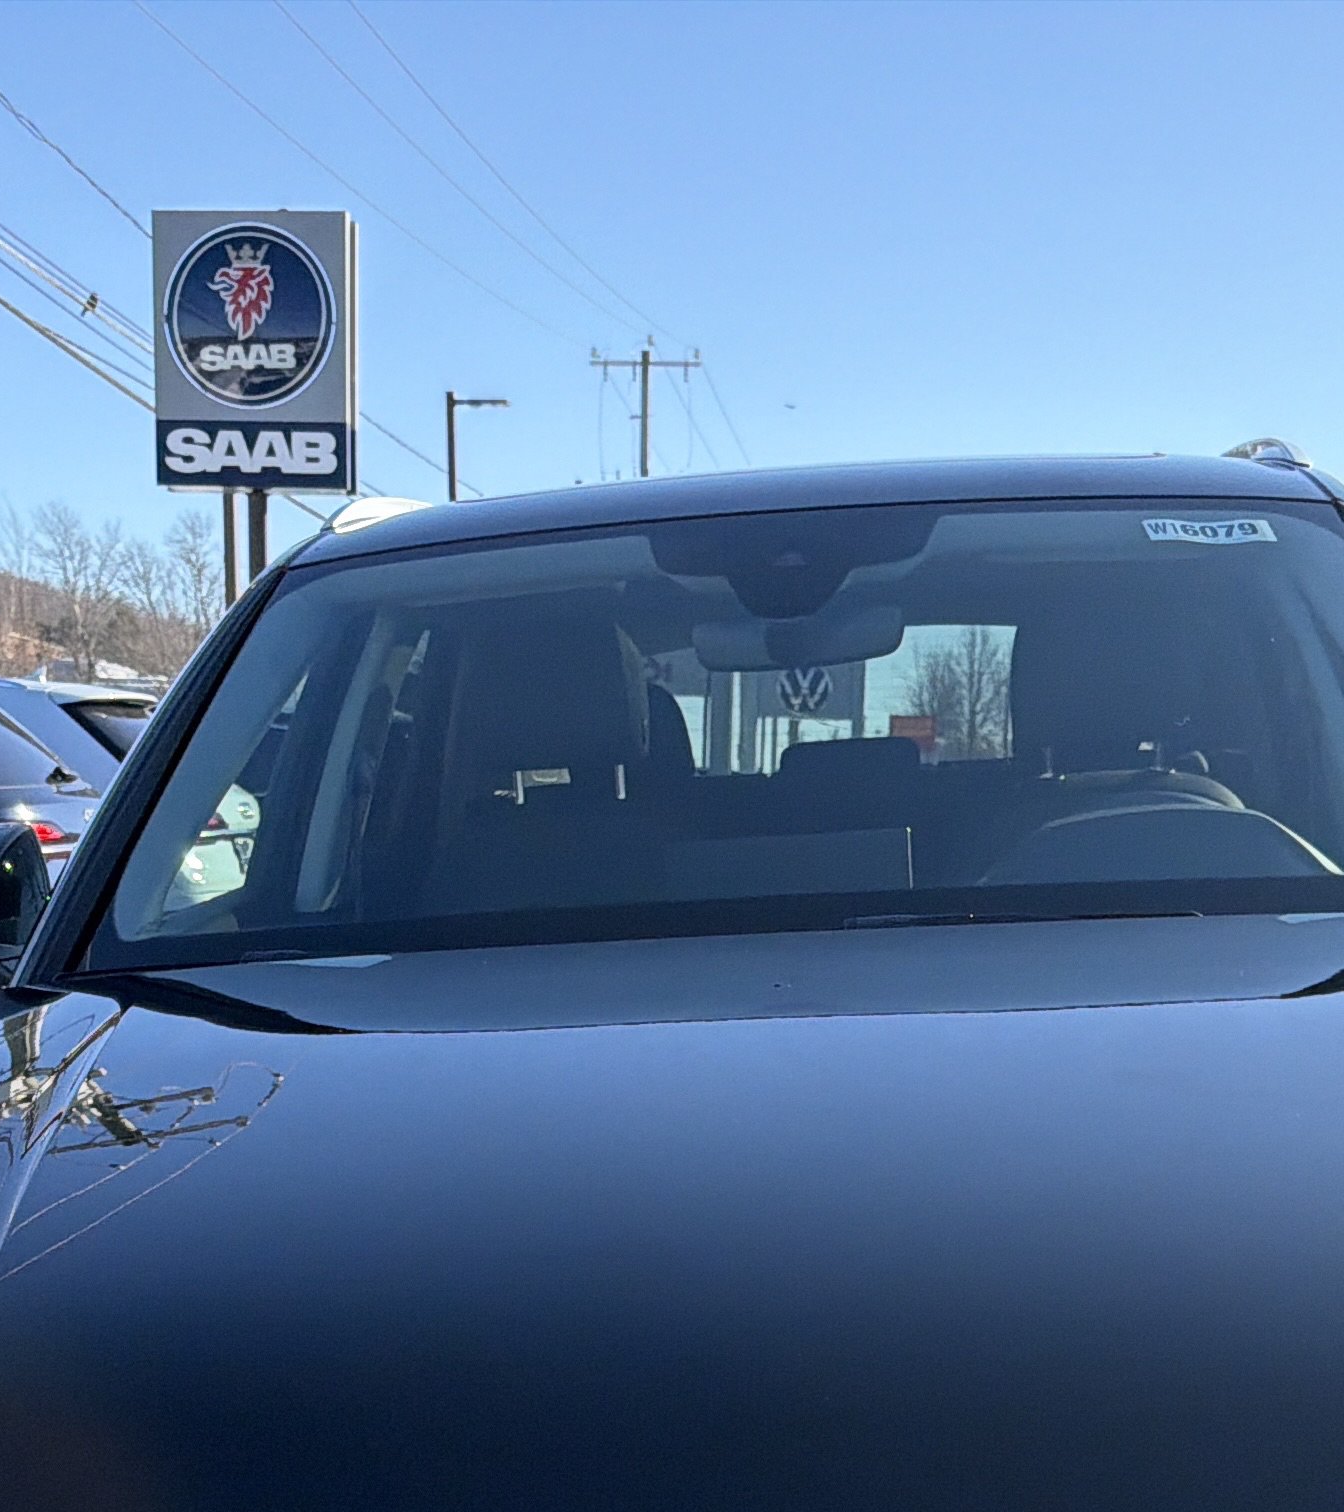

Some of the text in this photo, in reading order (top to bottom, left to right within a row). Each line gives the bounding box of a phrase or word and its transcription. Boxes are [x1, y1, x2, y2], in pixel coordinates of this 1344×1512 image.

[199, 343, 297, 372] SAAB
[164, 427, 338, 475] SAAB
[1146, 522, 1259, 539] W16079
